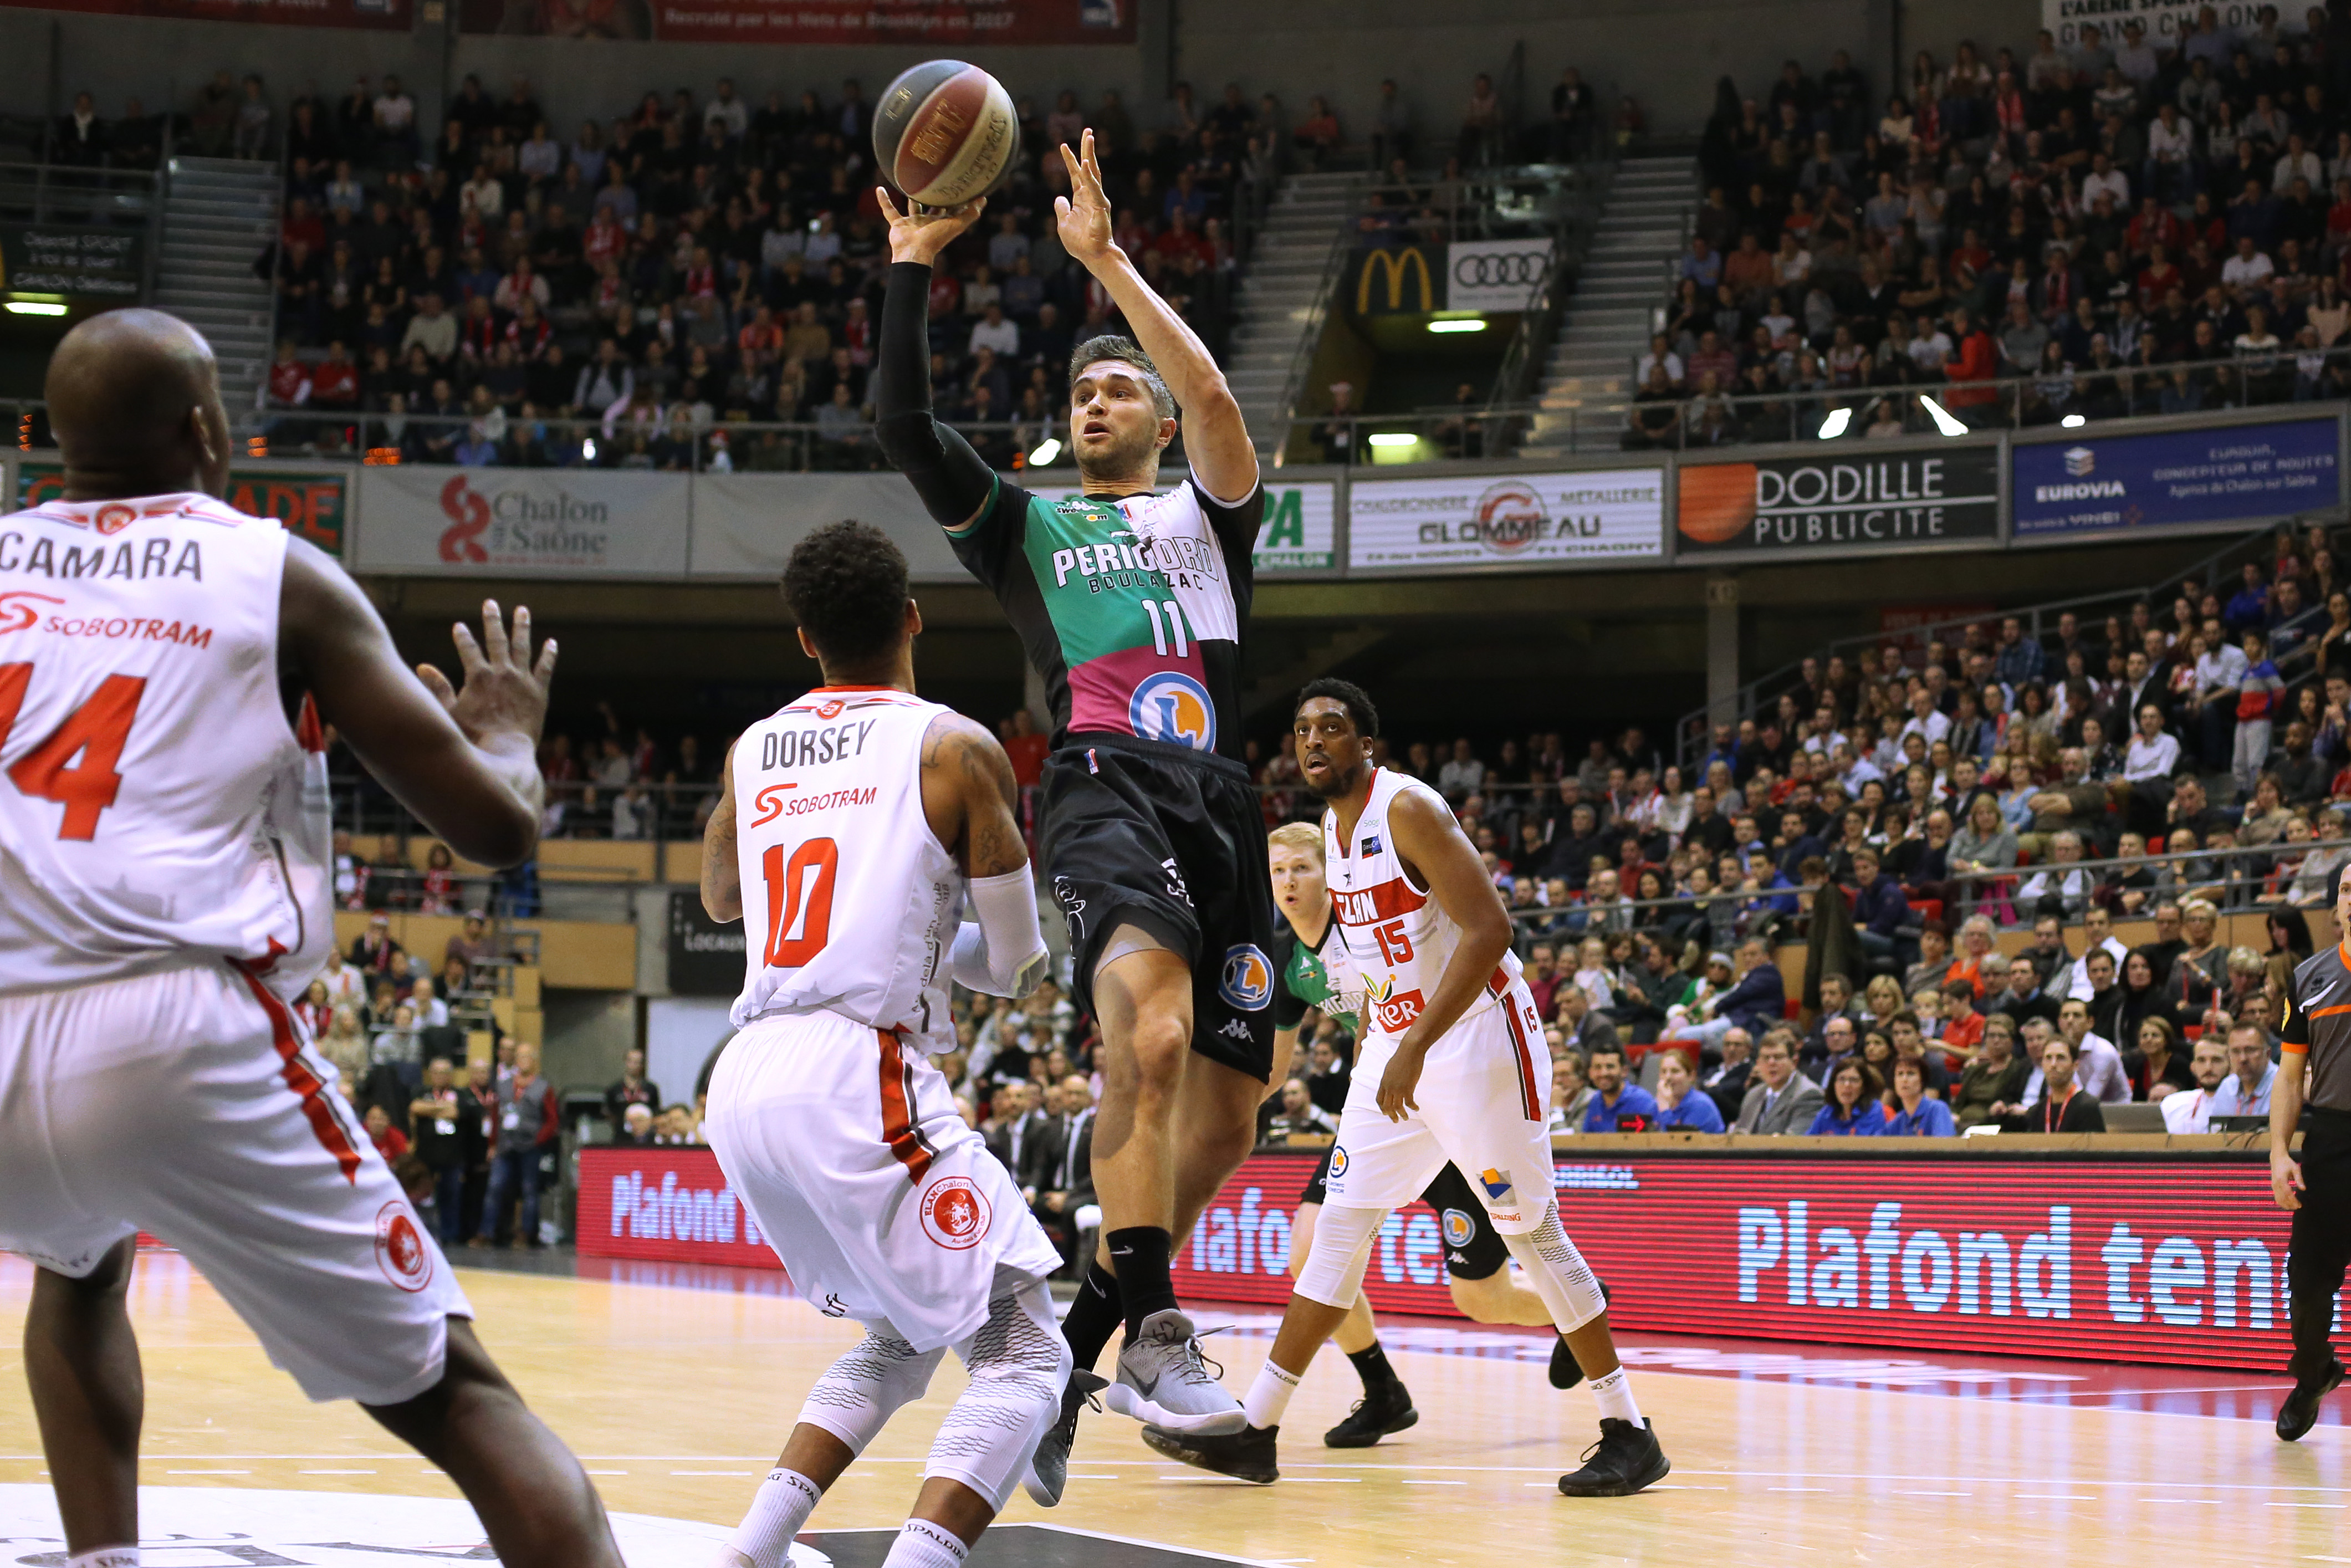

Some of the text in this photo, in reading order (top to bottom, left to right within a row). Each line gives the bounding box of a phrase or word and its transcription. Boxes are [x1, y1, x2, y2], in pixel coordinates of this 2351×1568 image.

[2159, 4, 2264, 34] CHON
[1756, 458, 1944, 508] DODILLE
[2036, 480, 2126, 503] EUROVIA
[494, 491, 608, 523] Chalon
[1755, 507, 1944, 544] PUBLICITE
[511, 520, 608, 553] Saône
[1419, 516, 1601, 545] GLOMMEAU
[0, 530, 202, 582] CAMARA
[1052, 536, 1219, 589] PERIGORD
[1088, 572, 1204, 595] BOULAZAC
[44, 616, 213, 650] SOBOTRAM
[1141, 599, 1188, 658] 11
[761, 718, 877, 771] DORSEY
[785, 786, 877, 816] SOBOTRAM
[762, 836, 839, 969] 10
[1373, 919, 1414, 968] 15
[1522, 1004, 1538, 1034] 15
[611, 1170, 738, 1244] Plafond
[924, 1181, 969, 1216] ELAN Chalon
[1737, 1199, 2071, 1319] Plafond
[904, 1524, 965, 1561] SPALDIN
